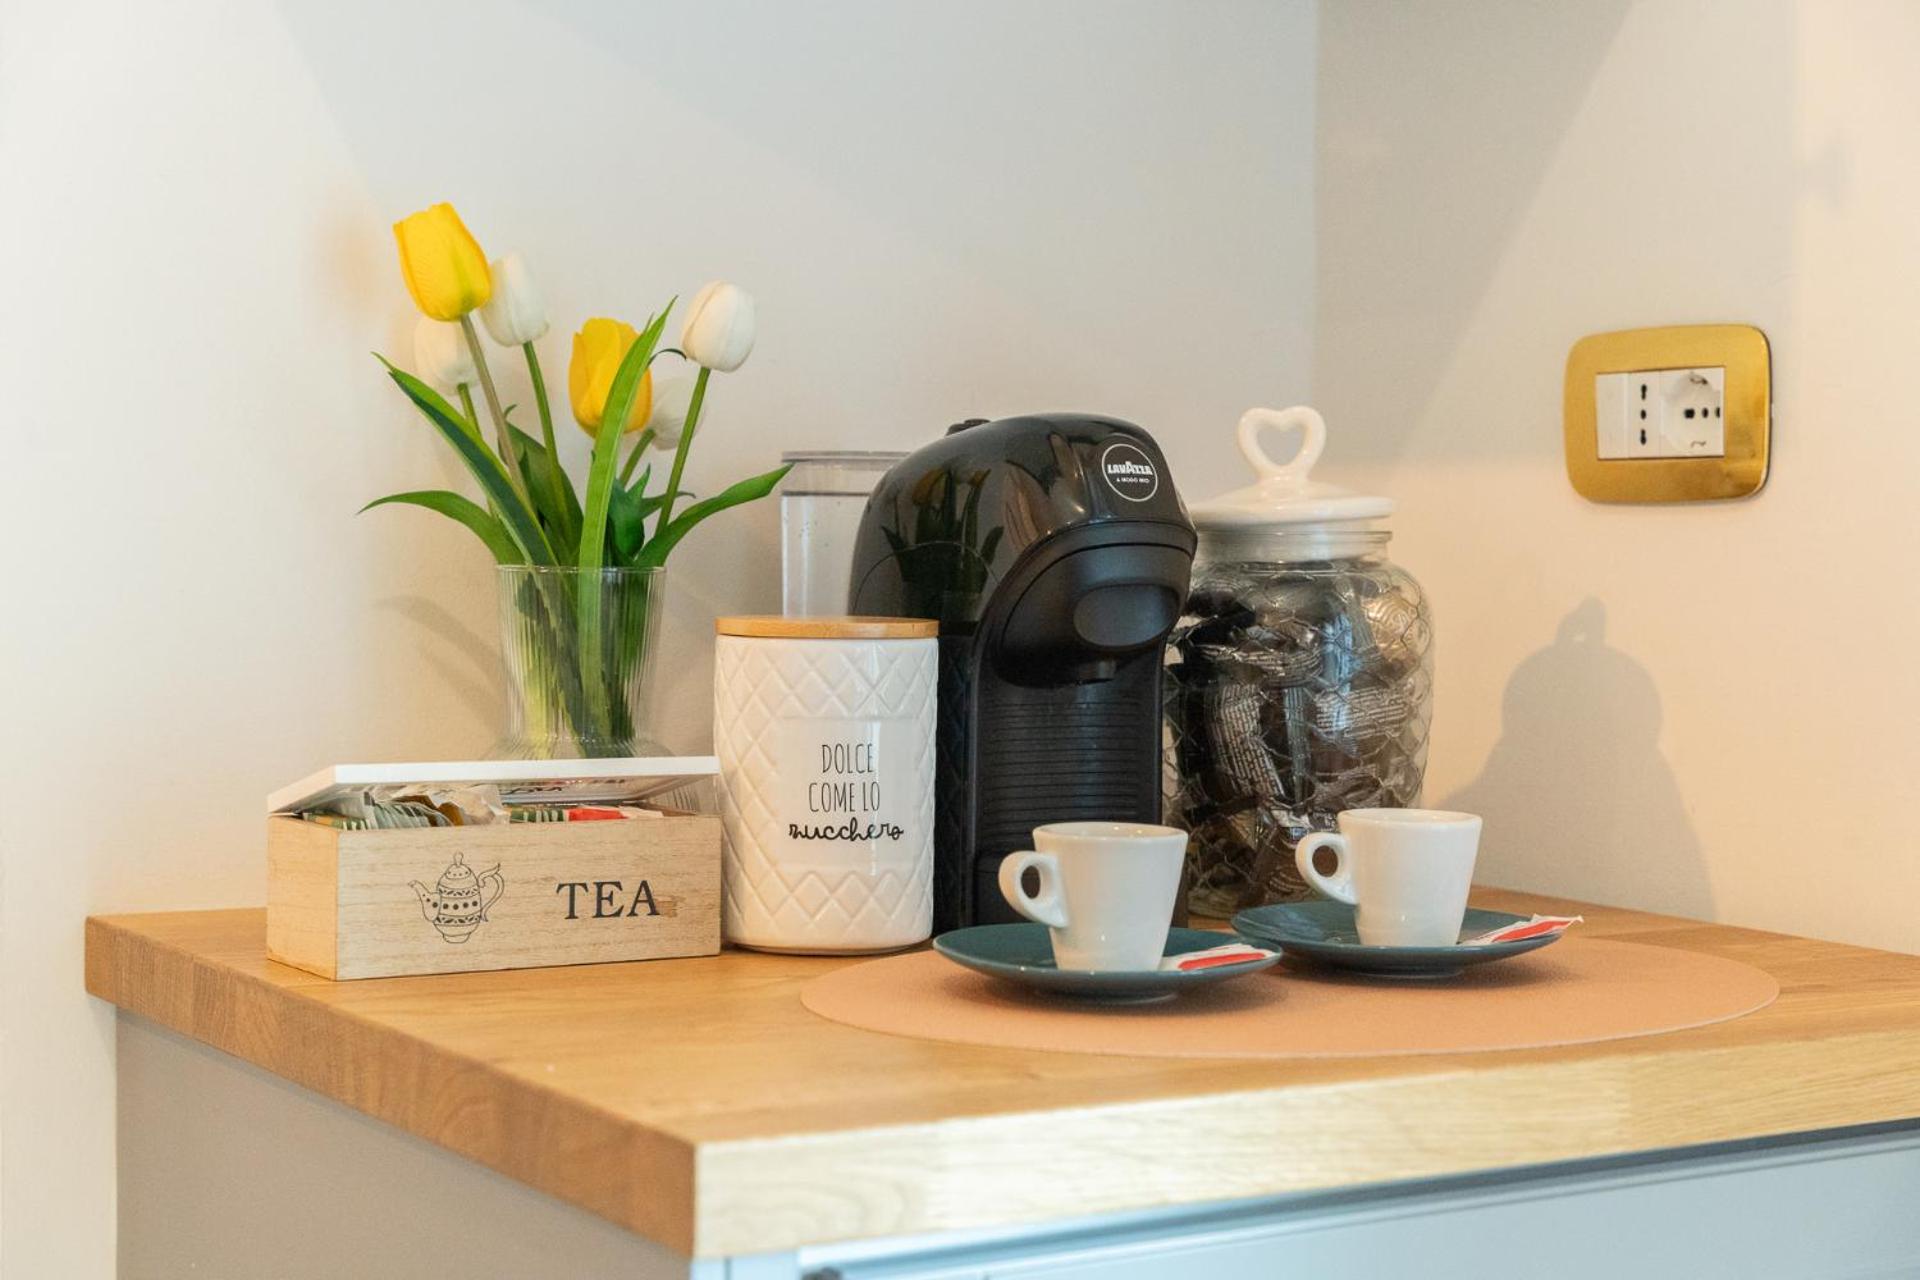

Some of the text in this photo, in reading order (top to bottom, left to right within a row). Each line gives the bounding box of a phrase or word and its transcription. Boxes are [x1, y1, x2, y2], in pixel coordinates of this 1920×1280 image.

[1107, 461, 1153, 475] LAVAZZA
[822, 743, 874, 774] DOLCE
[808, 781, 880, 813] COME LO
[789, 817, 904, 841] zucchero
[556, 880, 660, 920] TEA
